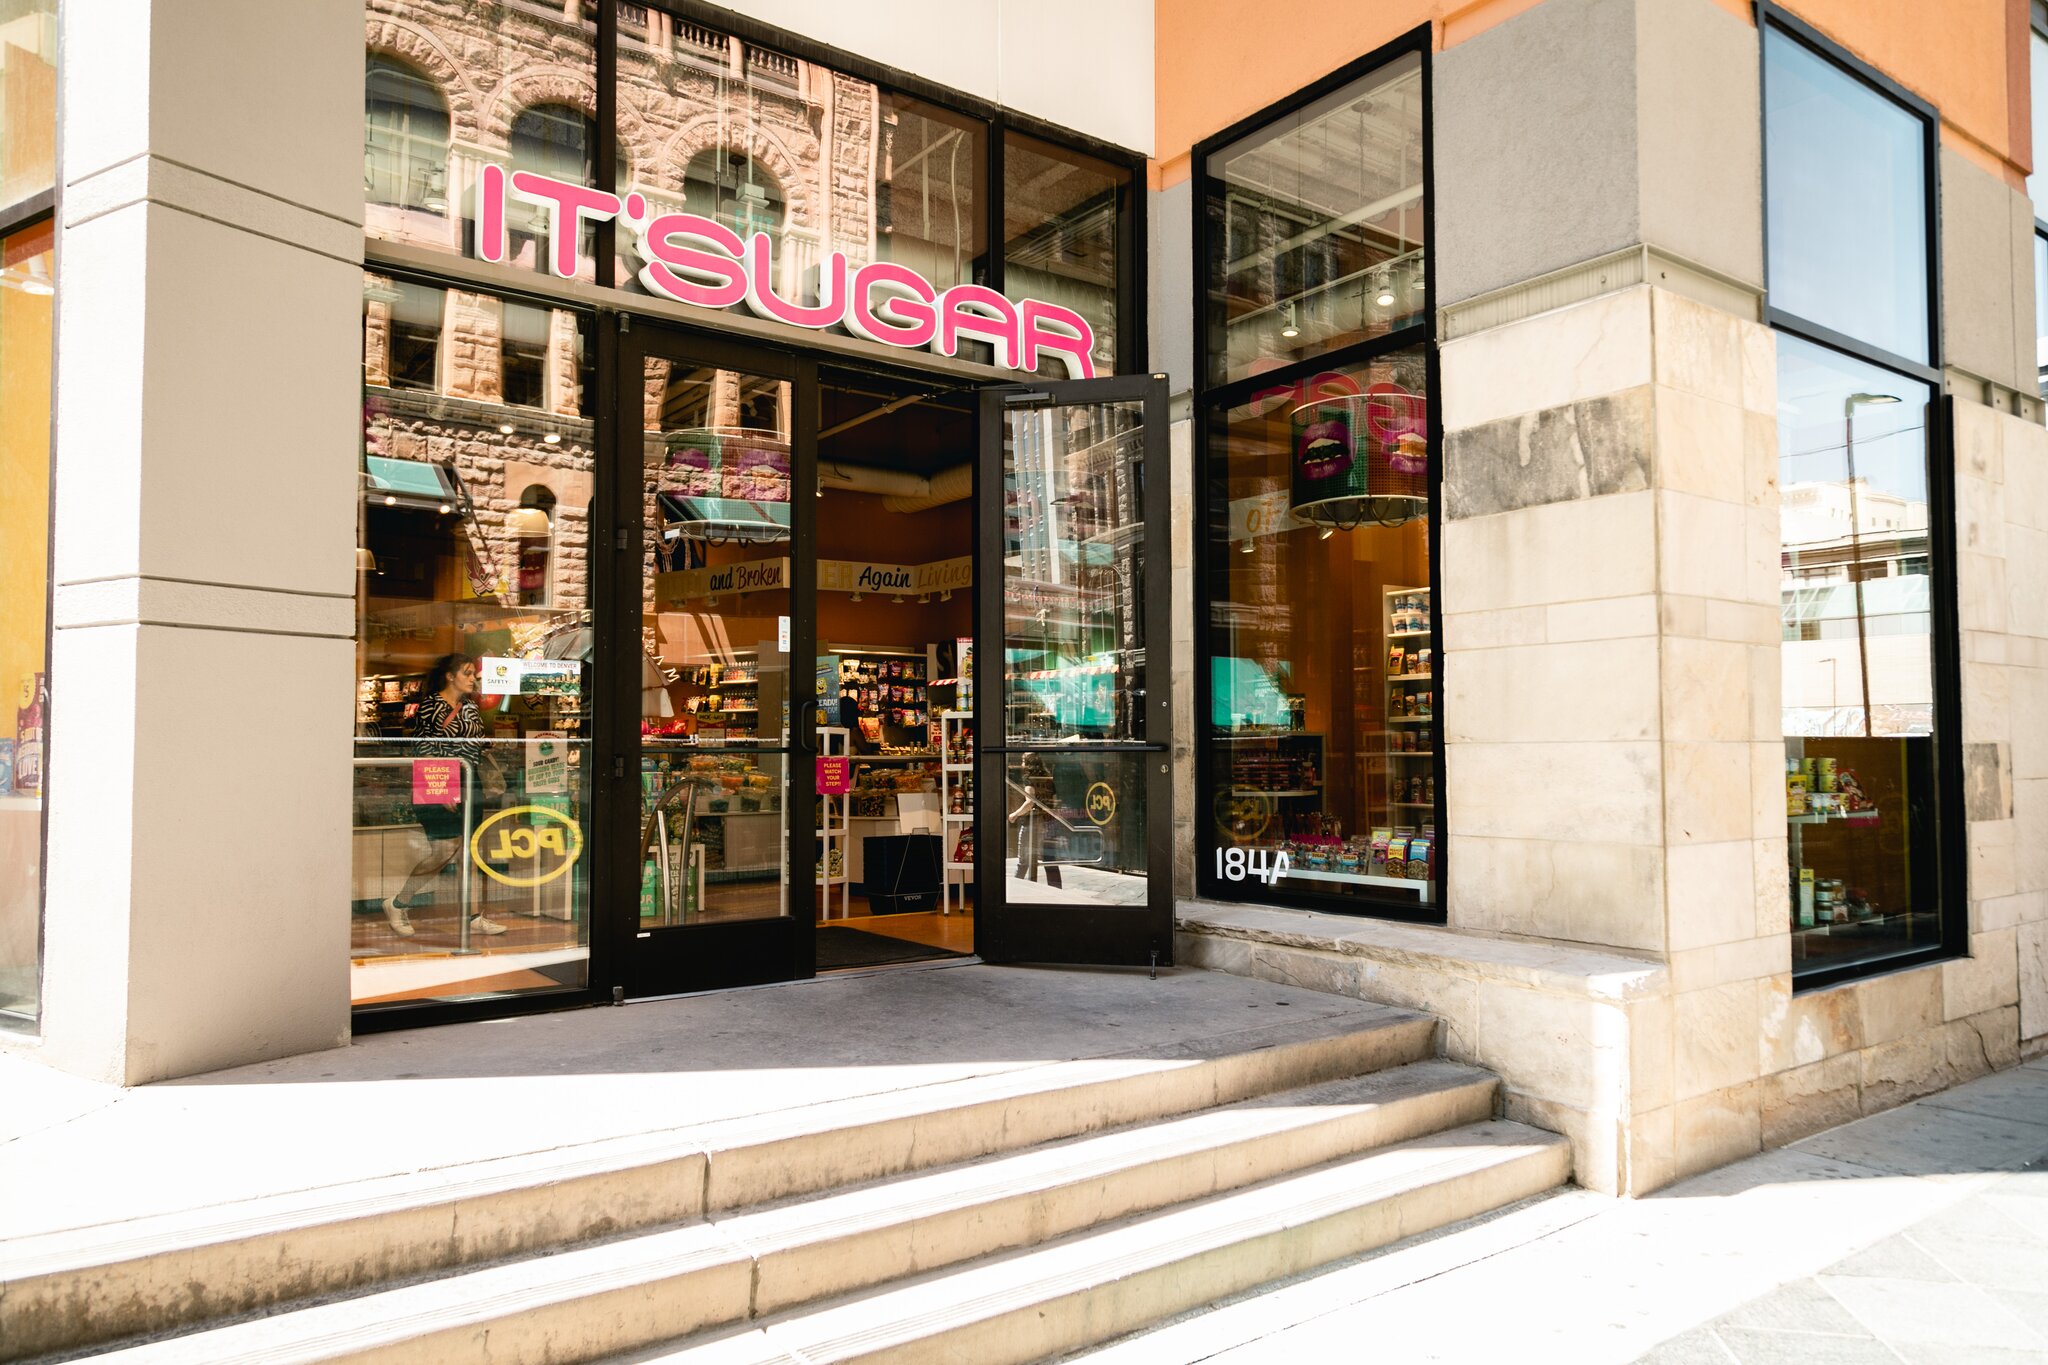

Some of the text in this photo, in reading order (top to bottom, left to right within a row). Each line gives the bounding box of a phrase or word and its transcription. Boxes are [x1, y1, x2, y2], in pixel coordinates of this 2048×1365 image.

[710, 567, 734, 592] and
[736, 560, 783, 590] Broken
[858, 565, 912, 591] Again
[918, 562, 970, 587] Living
[523, 661, 548, 669] WELCOME
[1215, 846, 1290, 885] 184A
